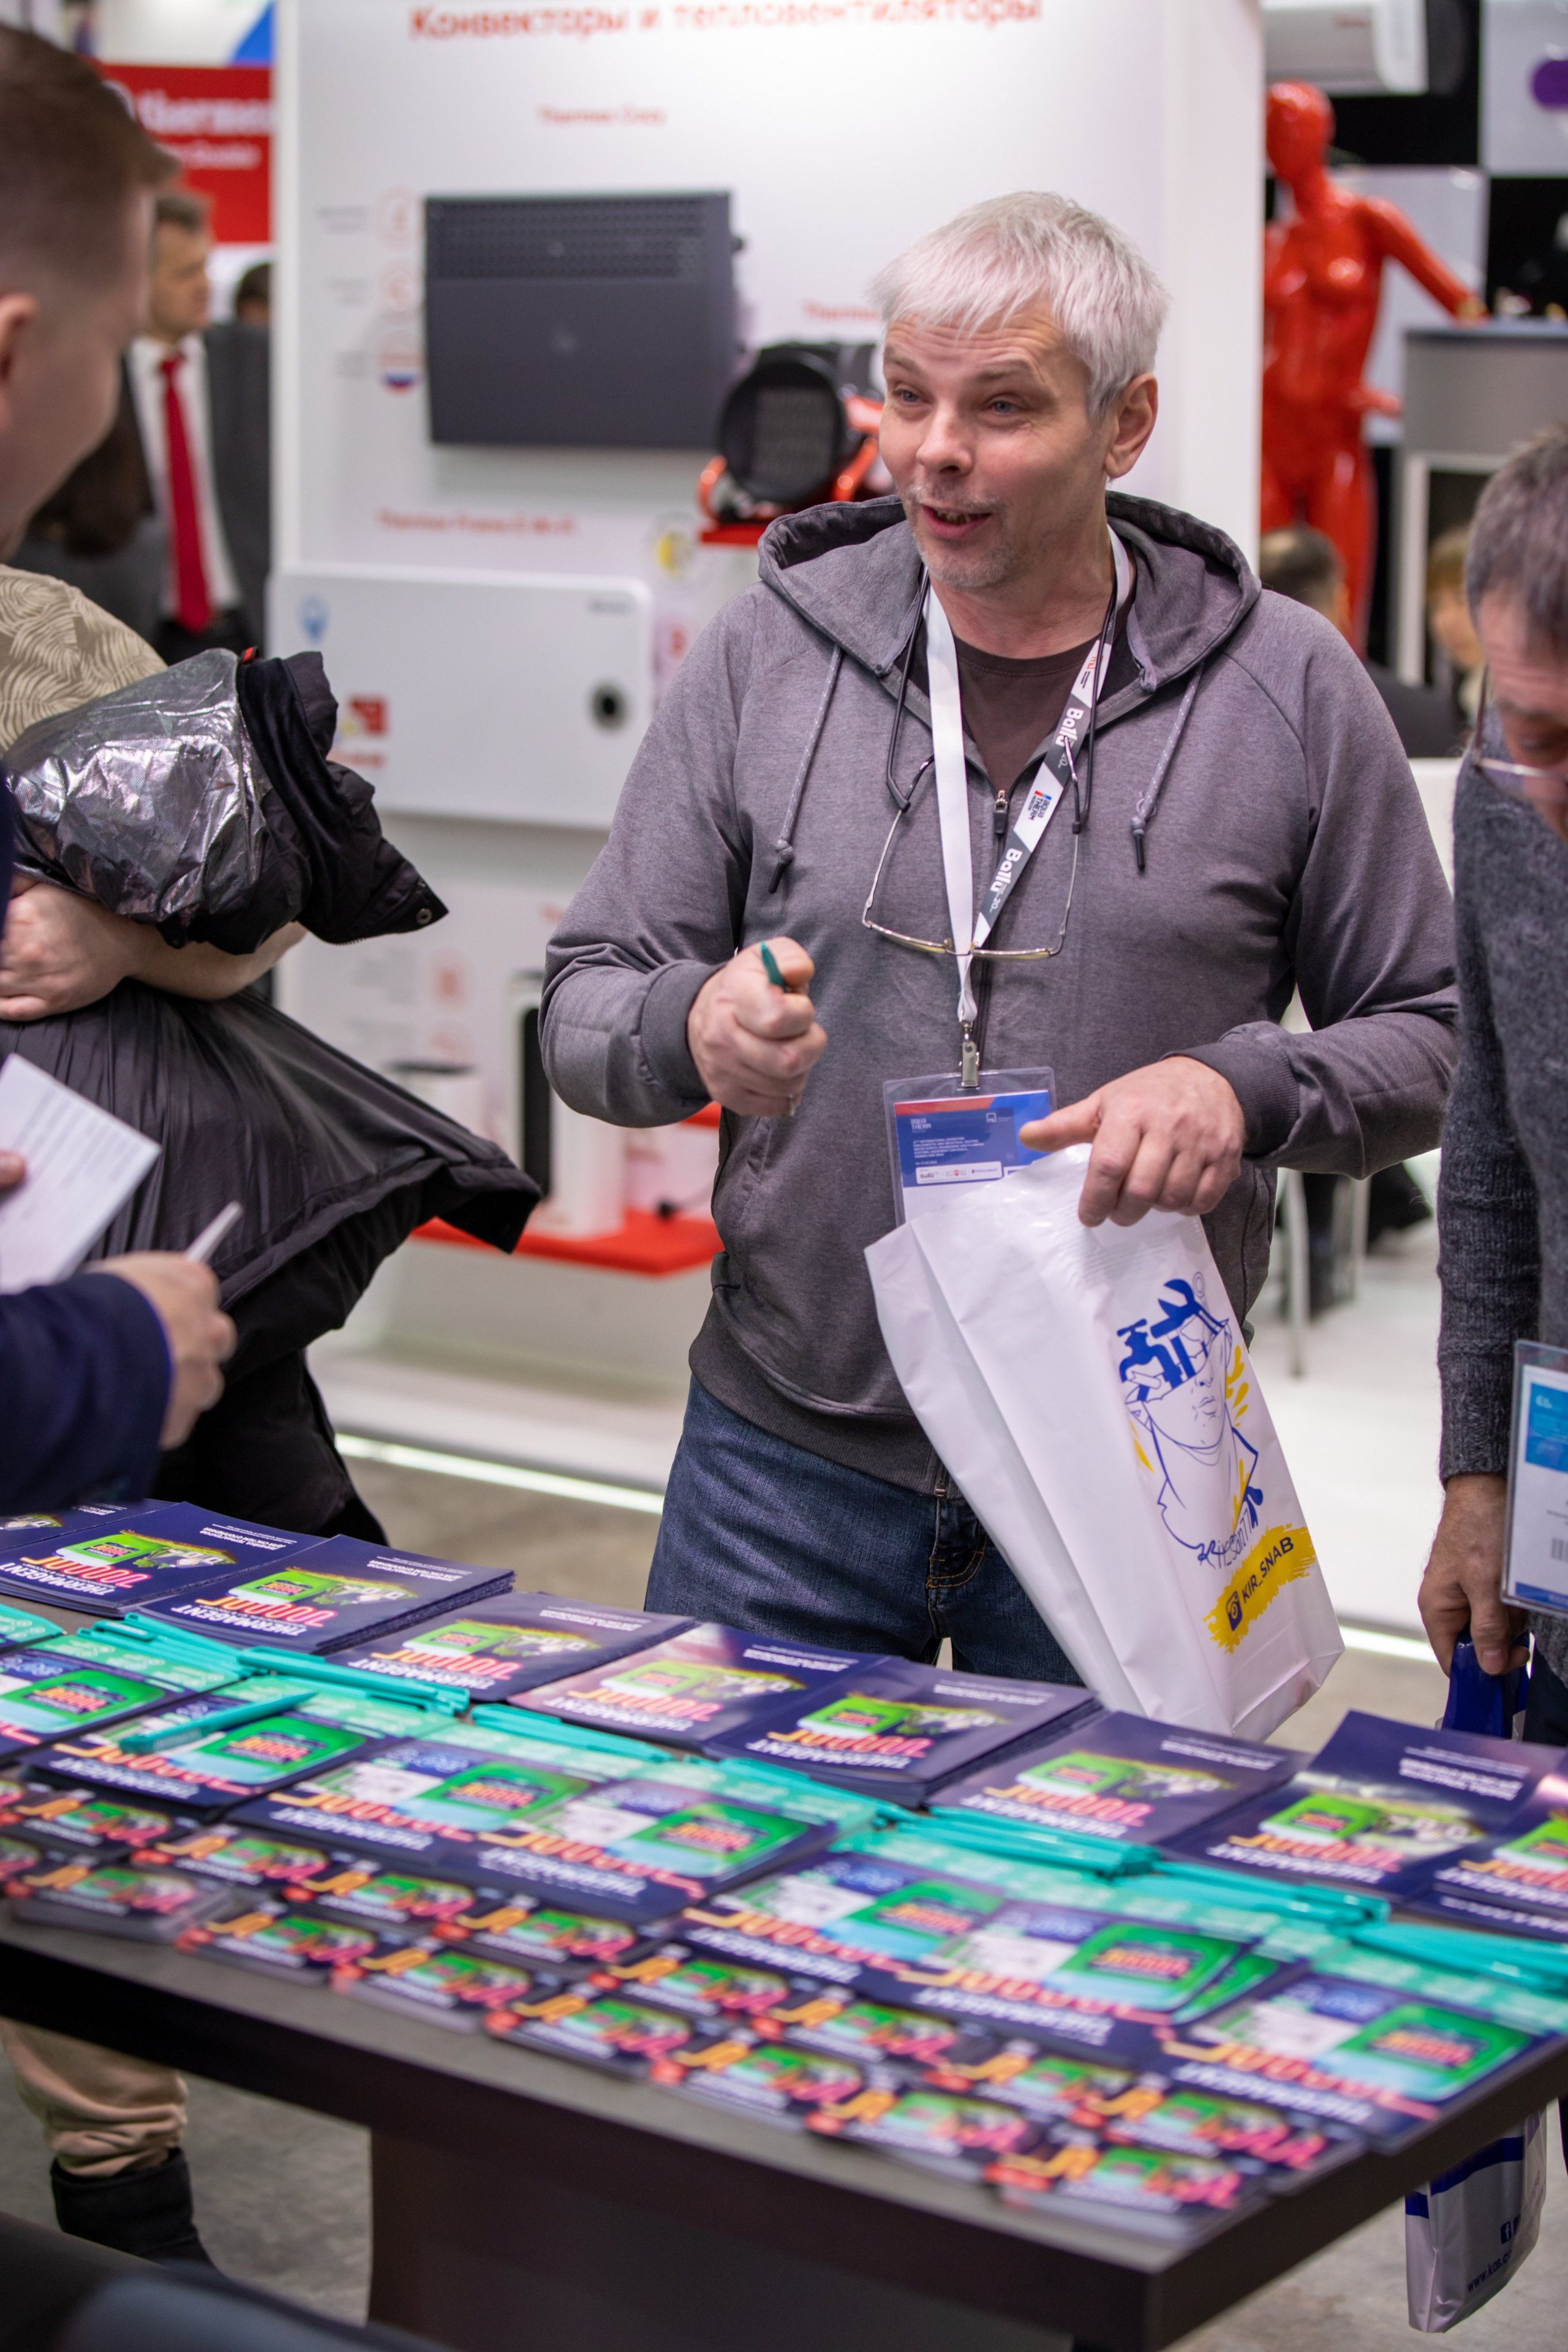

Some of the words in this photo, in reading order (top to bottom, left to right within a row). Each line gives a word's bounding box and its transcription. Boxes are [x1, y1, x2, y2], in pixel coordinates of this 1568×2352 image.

[1055, 707, 1084, 747] Ballu
[1028, 797, 1044, 821] THERM
[1037, 799, 1050, 818] aqua
[990, 848, 1023, 892] Ballu
[0, 1562, 115, 1596] THERMAGENT
[1242, 1537, 1294, 1604] KIR_SNAB
[171, 1605, 307, 1636] THERMAGENT
